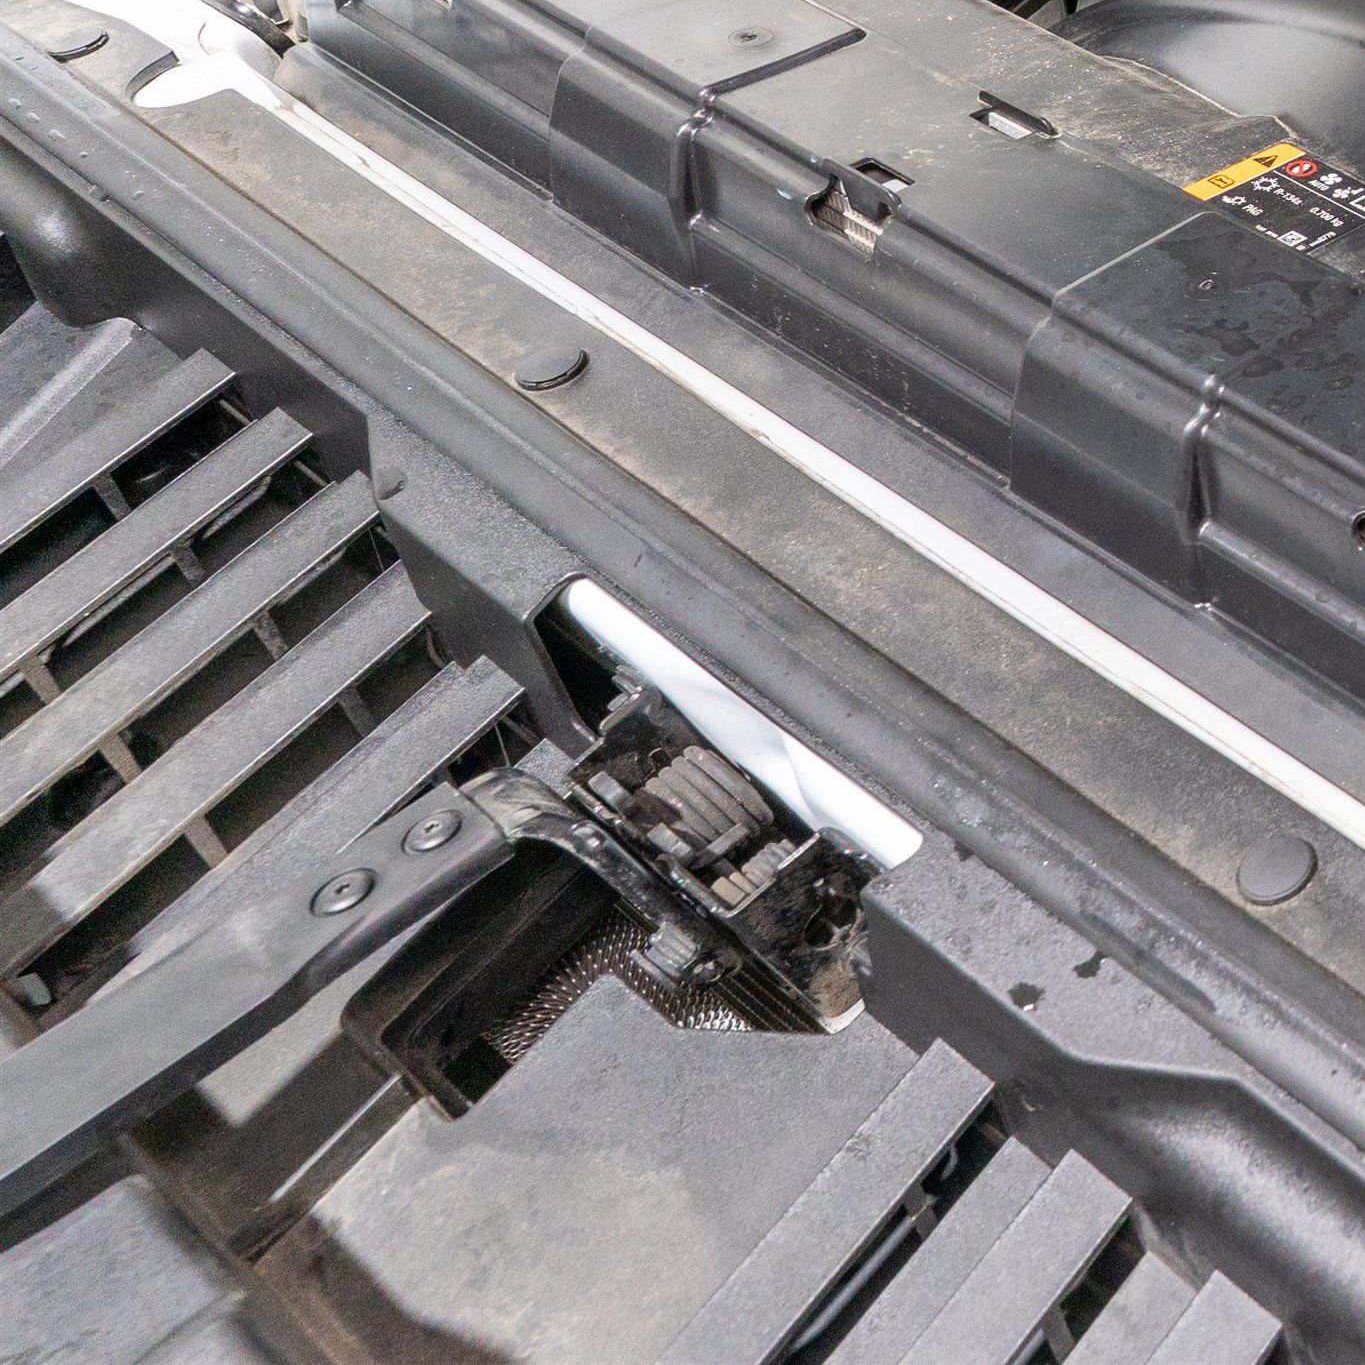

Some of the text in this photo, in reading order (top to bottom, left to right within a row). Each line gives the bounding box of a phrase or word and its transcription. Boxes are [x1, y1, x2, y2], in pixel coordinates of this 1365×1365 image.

[1308, 179, 1330, 191] AUTO
[1242, 204, 1263, 216] PAG
[1274, 188, 1344, 227] R-134a 0.700 kg
